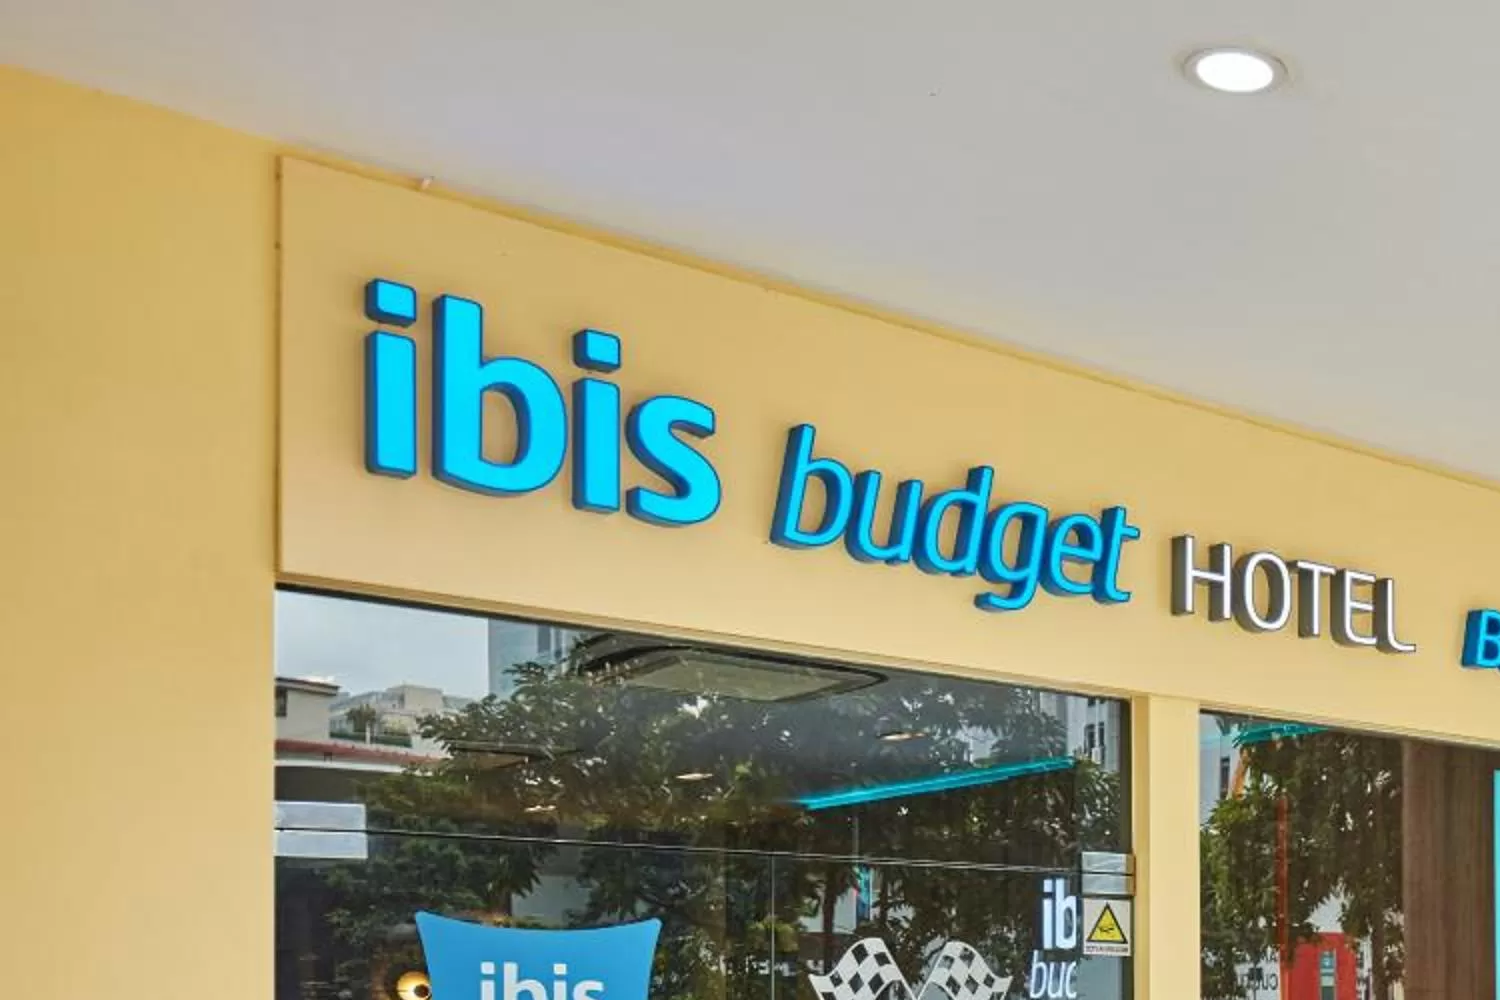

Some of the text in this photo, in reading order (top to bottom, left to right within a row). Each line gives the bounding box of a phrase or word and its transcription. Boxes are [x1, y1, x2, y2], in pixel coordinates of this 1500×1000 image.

[365, 278, 722, 527] ibis
[769, 423, 1141, 612] budget
[1170, 534, 1417, 654] HOTEL
